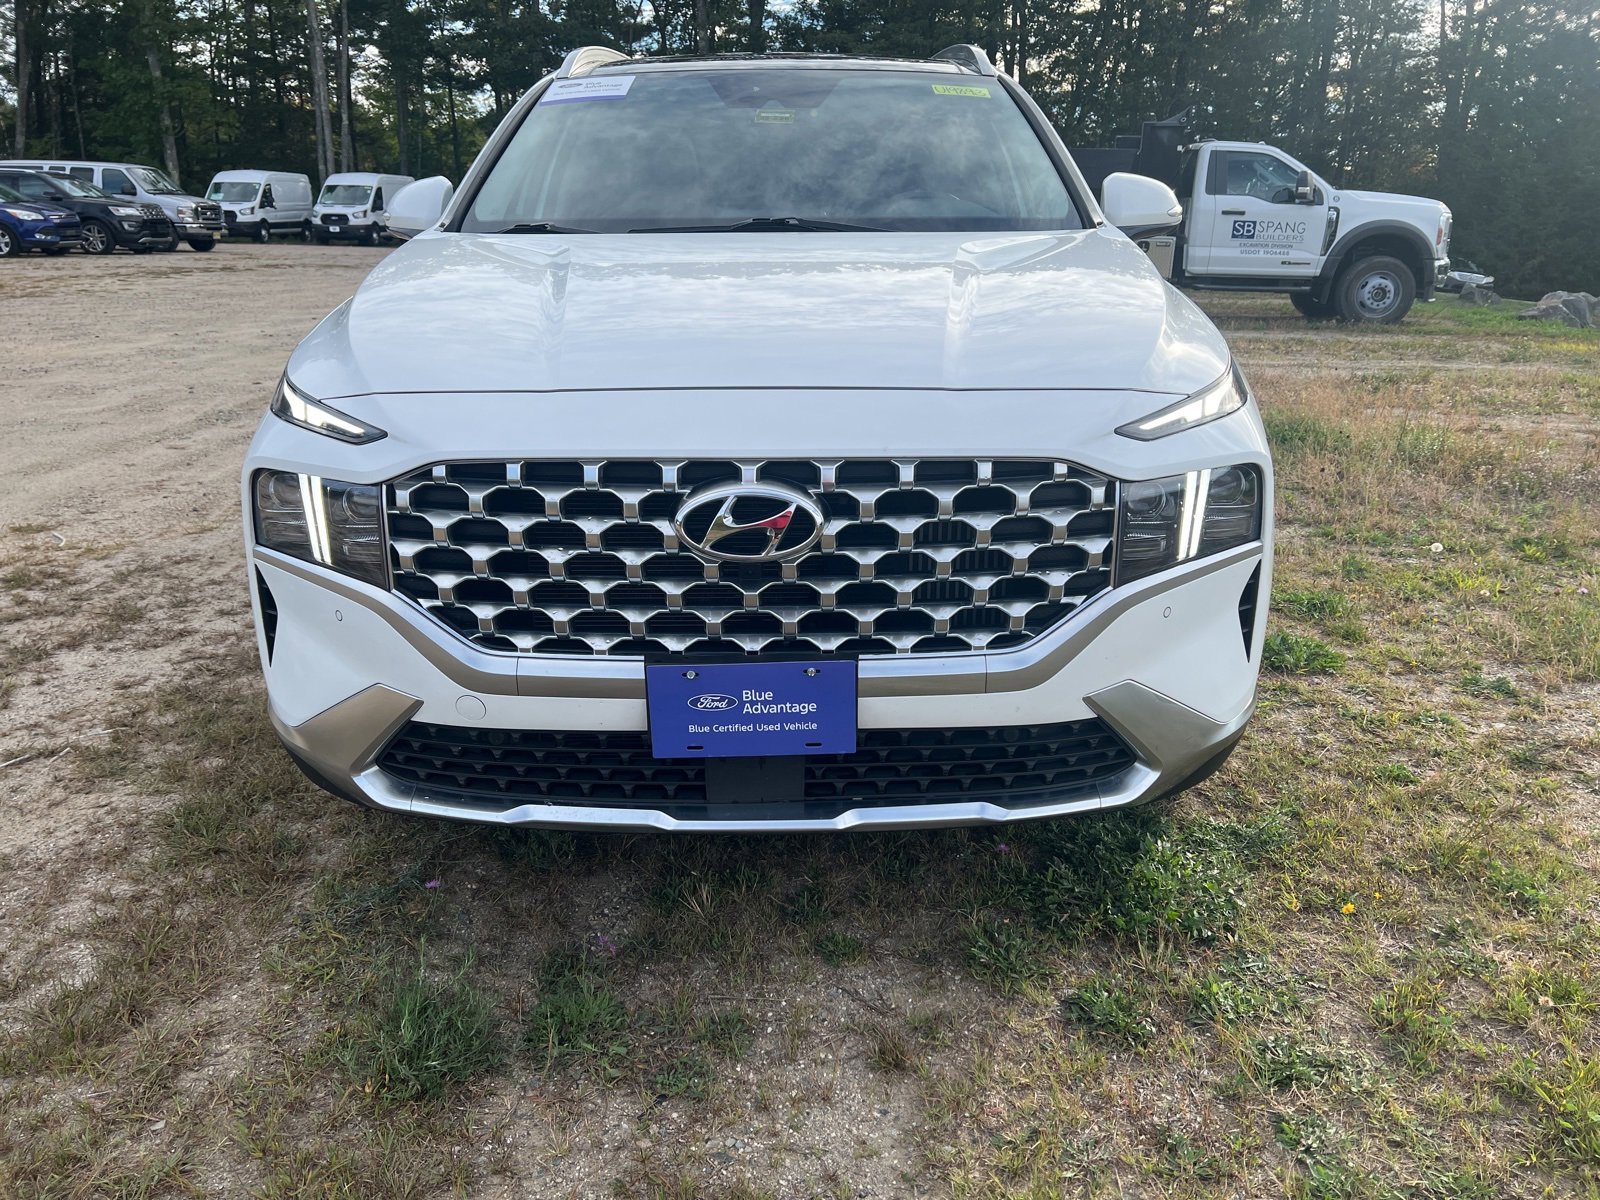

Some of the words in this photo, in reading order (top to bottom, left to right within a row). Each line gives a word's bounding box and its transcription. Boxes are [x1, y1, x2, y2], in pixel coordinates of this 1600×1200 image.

[1233, 221, 1255, 236] SB
[1257, 220, 1306, 235] SPANG
[1256, 234, 1304, 242] BUILDERS
[742, 689, 773, 701] Blue
[697, 696, 729, 709] Ford
[742, 701, 817, 715] Advantage
[689, 724, 710, 733] Blue
[712, 723, 753, 733] Certified
[756, 722, 781, 731] Used
[783, 721, 818, 731] Vehicle
